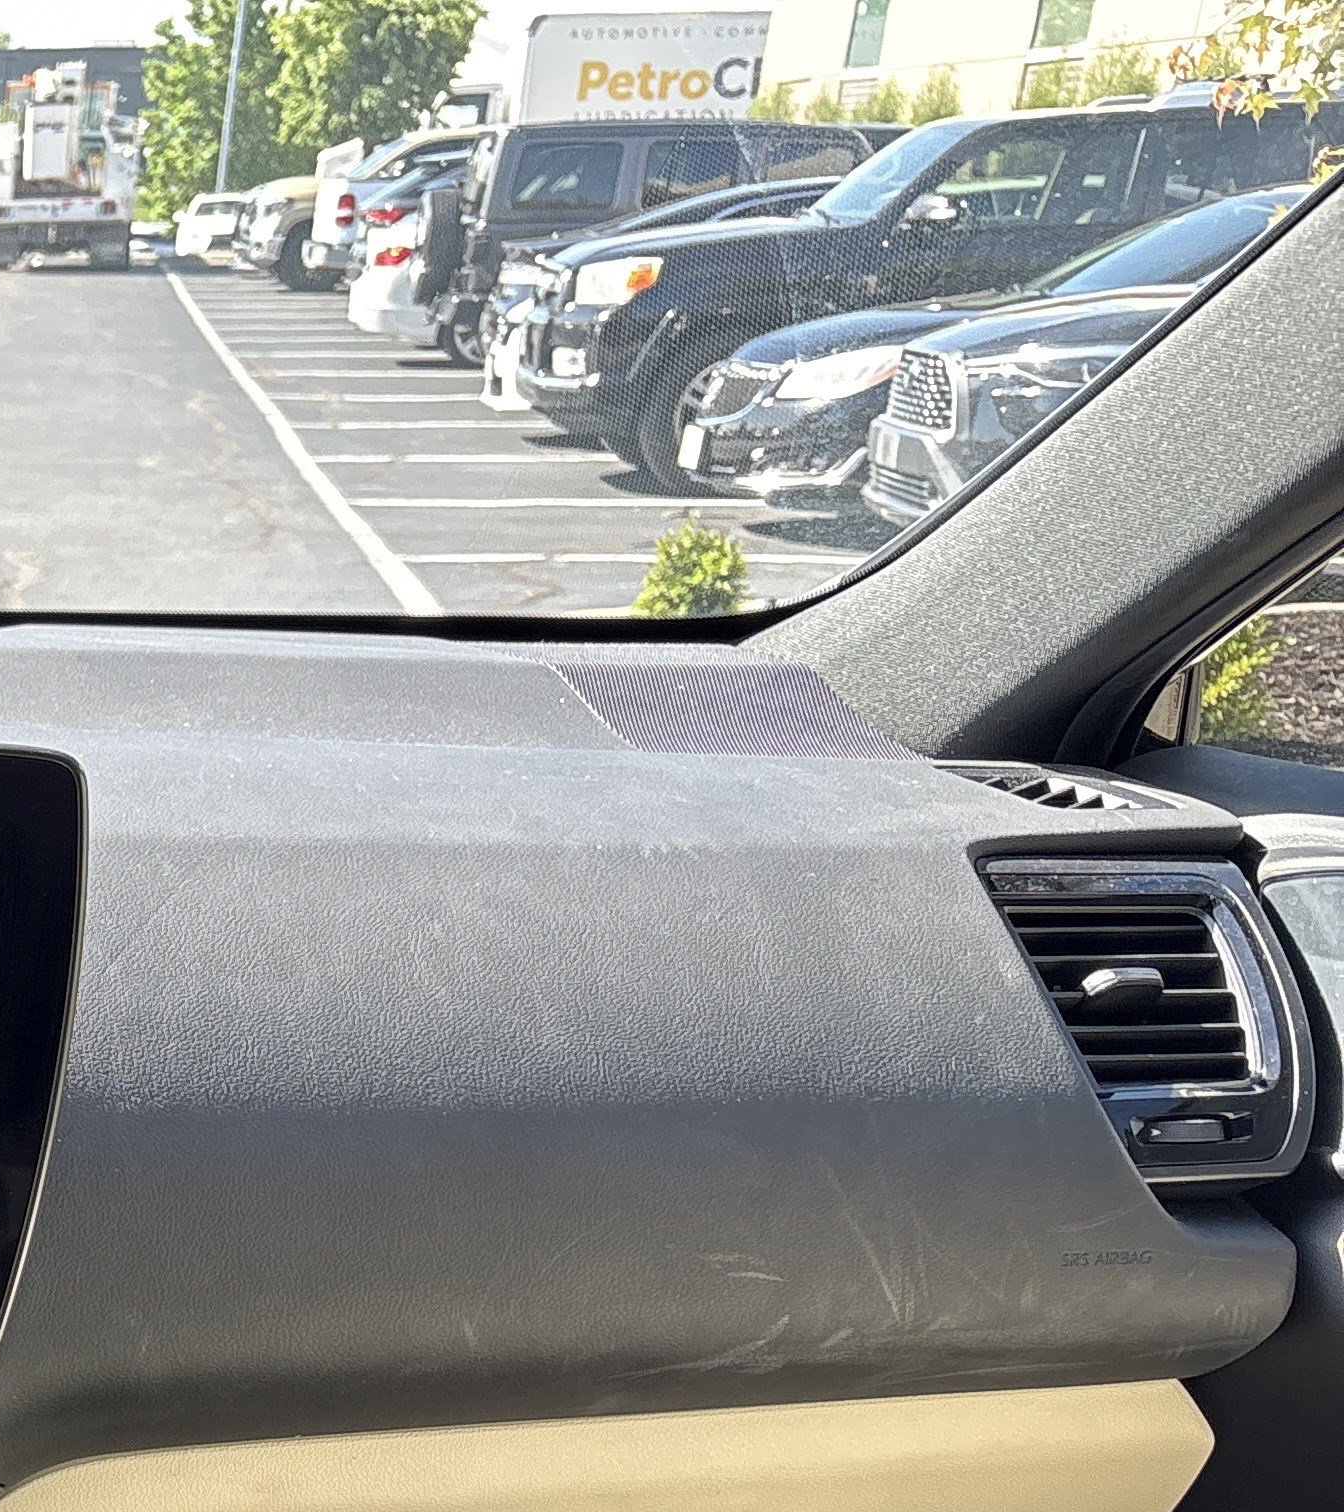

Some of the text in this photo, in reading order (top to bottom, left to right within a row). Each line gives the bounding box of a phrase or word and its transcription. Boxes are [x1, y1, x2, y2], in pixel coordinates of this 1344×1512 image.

[569, 25, 693, 41] AUTOMOTIVE
[1061, 1250, 1155, 1268] SRS AIRBAG
